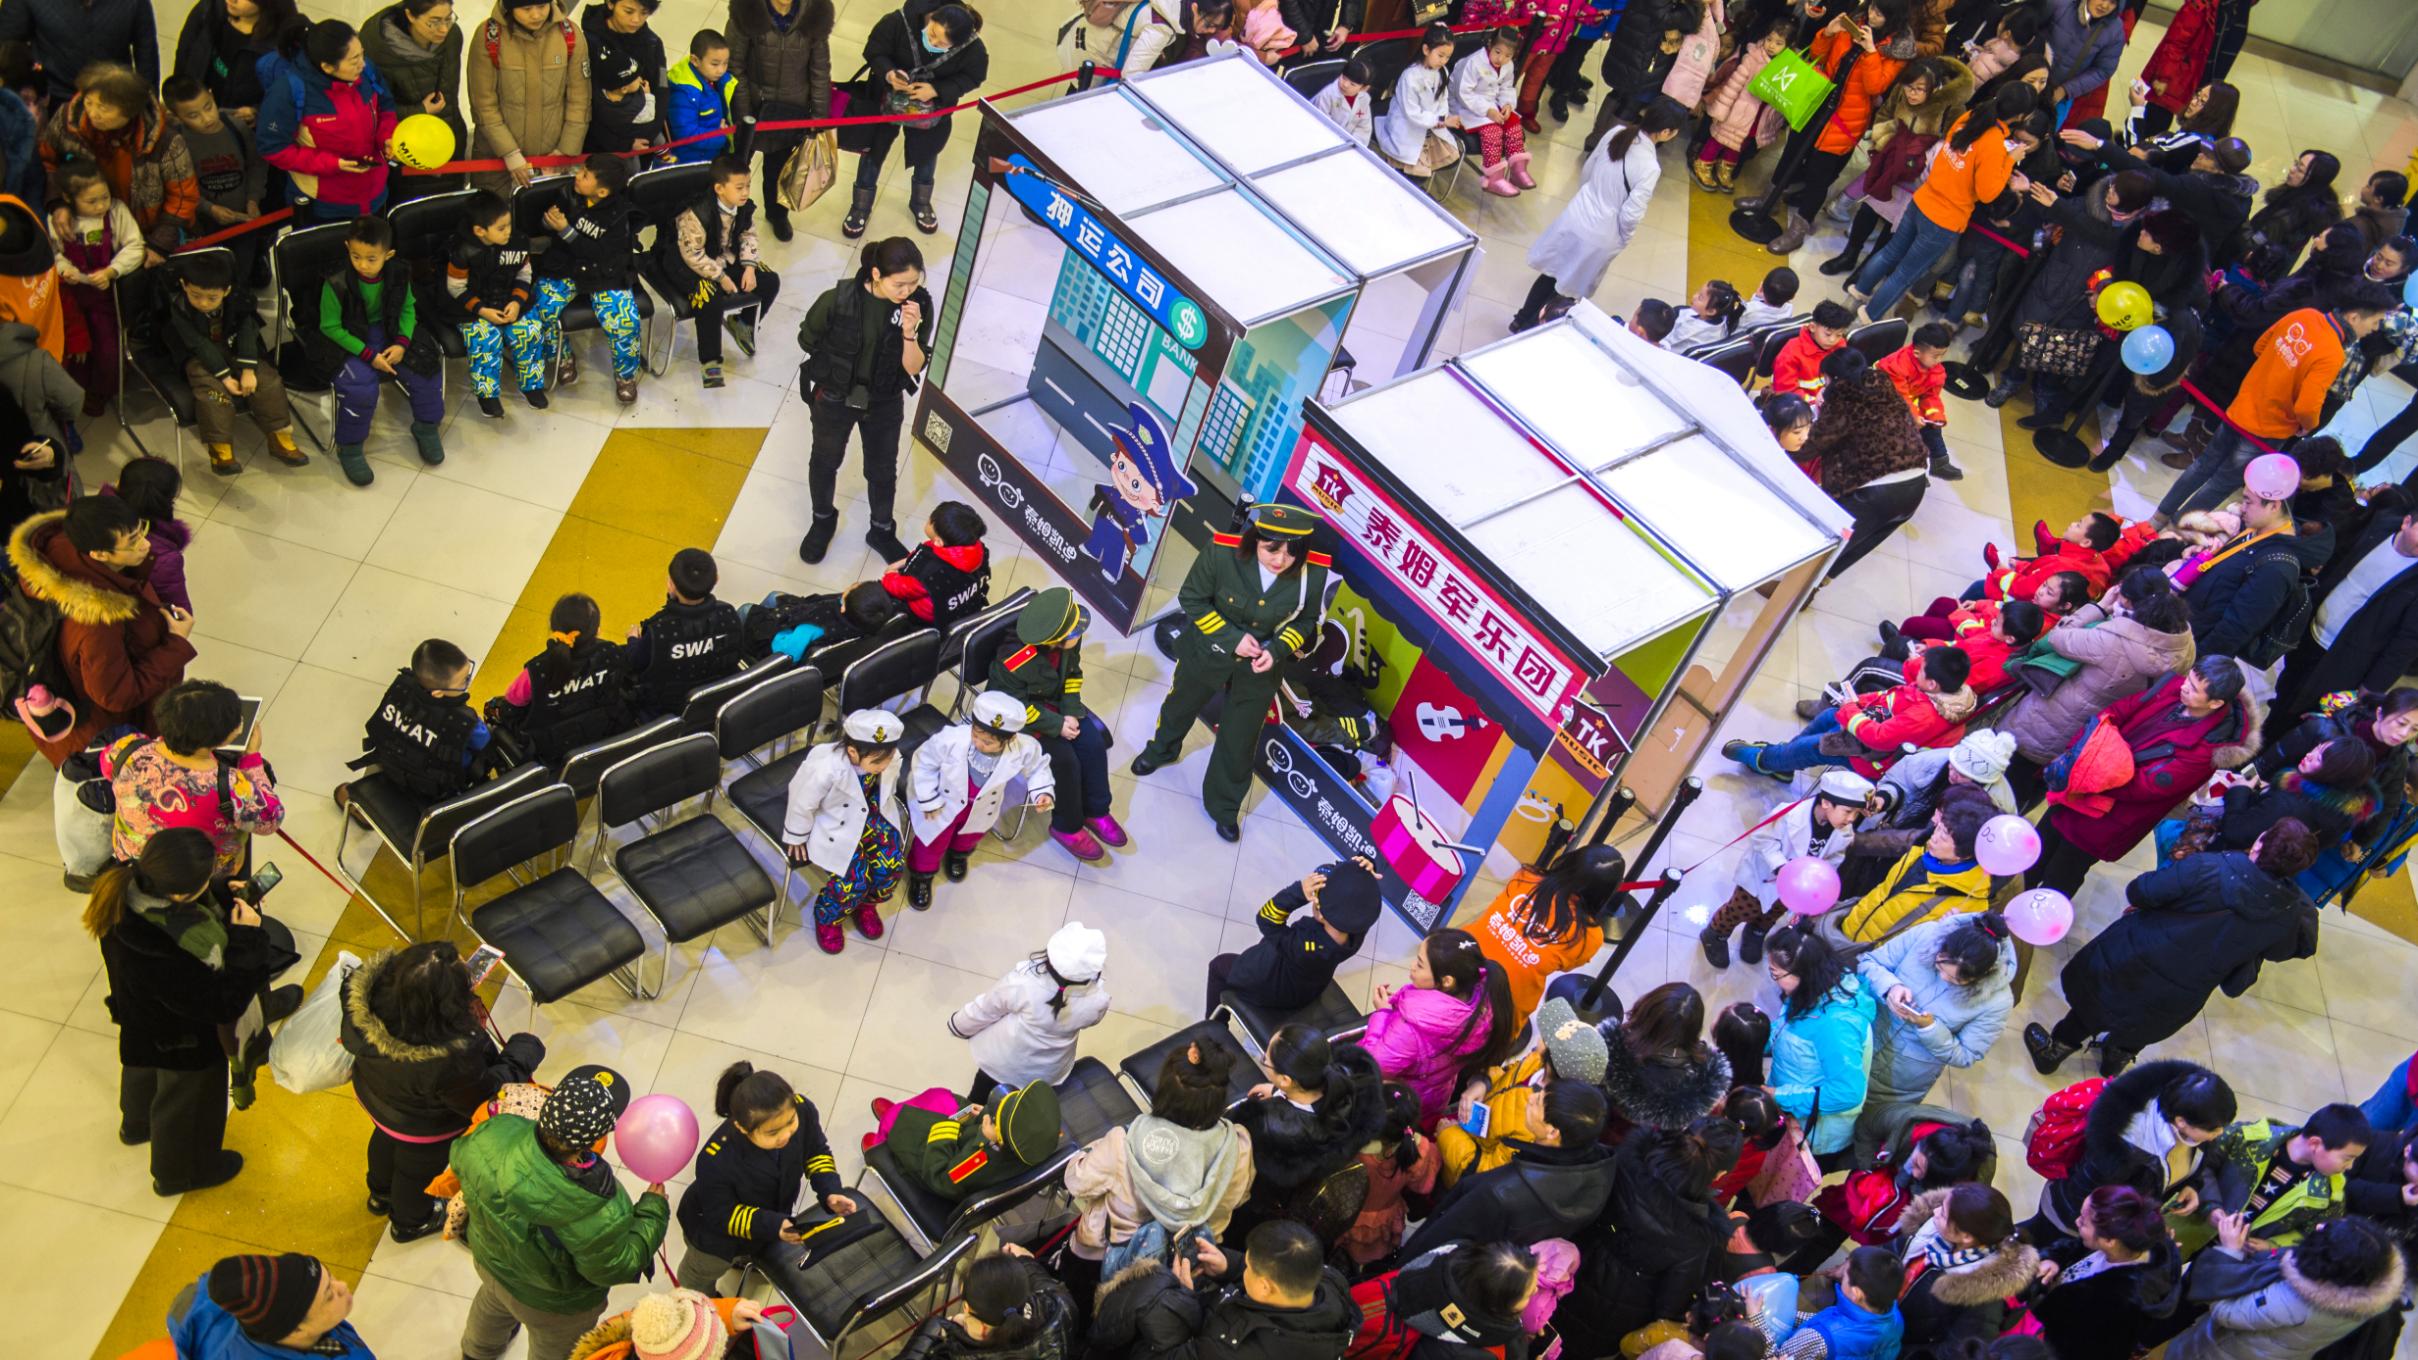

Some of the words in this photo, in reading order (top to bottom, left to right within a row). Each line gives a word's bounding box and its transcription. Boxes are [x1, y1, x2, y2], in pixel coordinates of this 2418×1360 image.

[576, 217, 607, 240] SWAT
[499, 250, 528, 266] SWAT
[1047, 191, 1166, 310] 押运公司
[1162, 333, 1199, 373] BANK
[1311, 484, 1342, 514] MUSIC
[1323, 474, 1343, 502] TK
[1024, 504, 1077, 560] 泰姆凯迪
[1361, 506, 1558, 697] 泰姆军乐团
[382, 703, 438, 748] SWAT
[1576, 717, 1609, 760] TK
[1558, 731, 1604, 775] MUSIC
[1489, 910, 1541, 966] 泰姆凯迪
